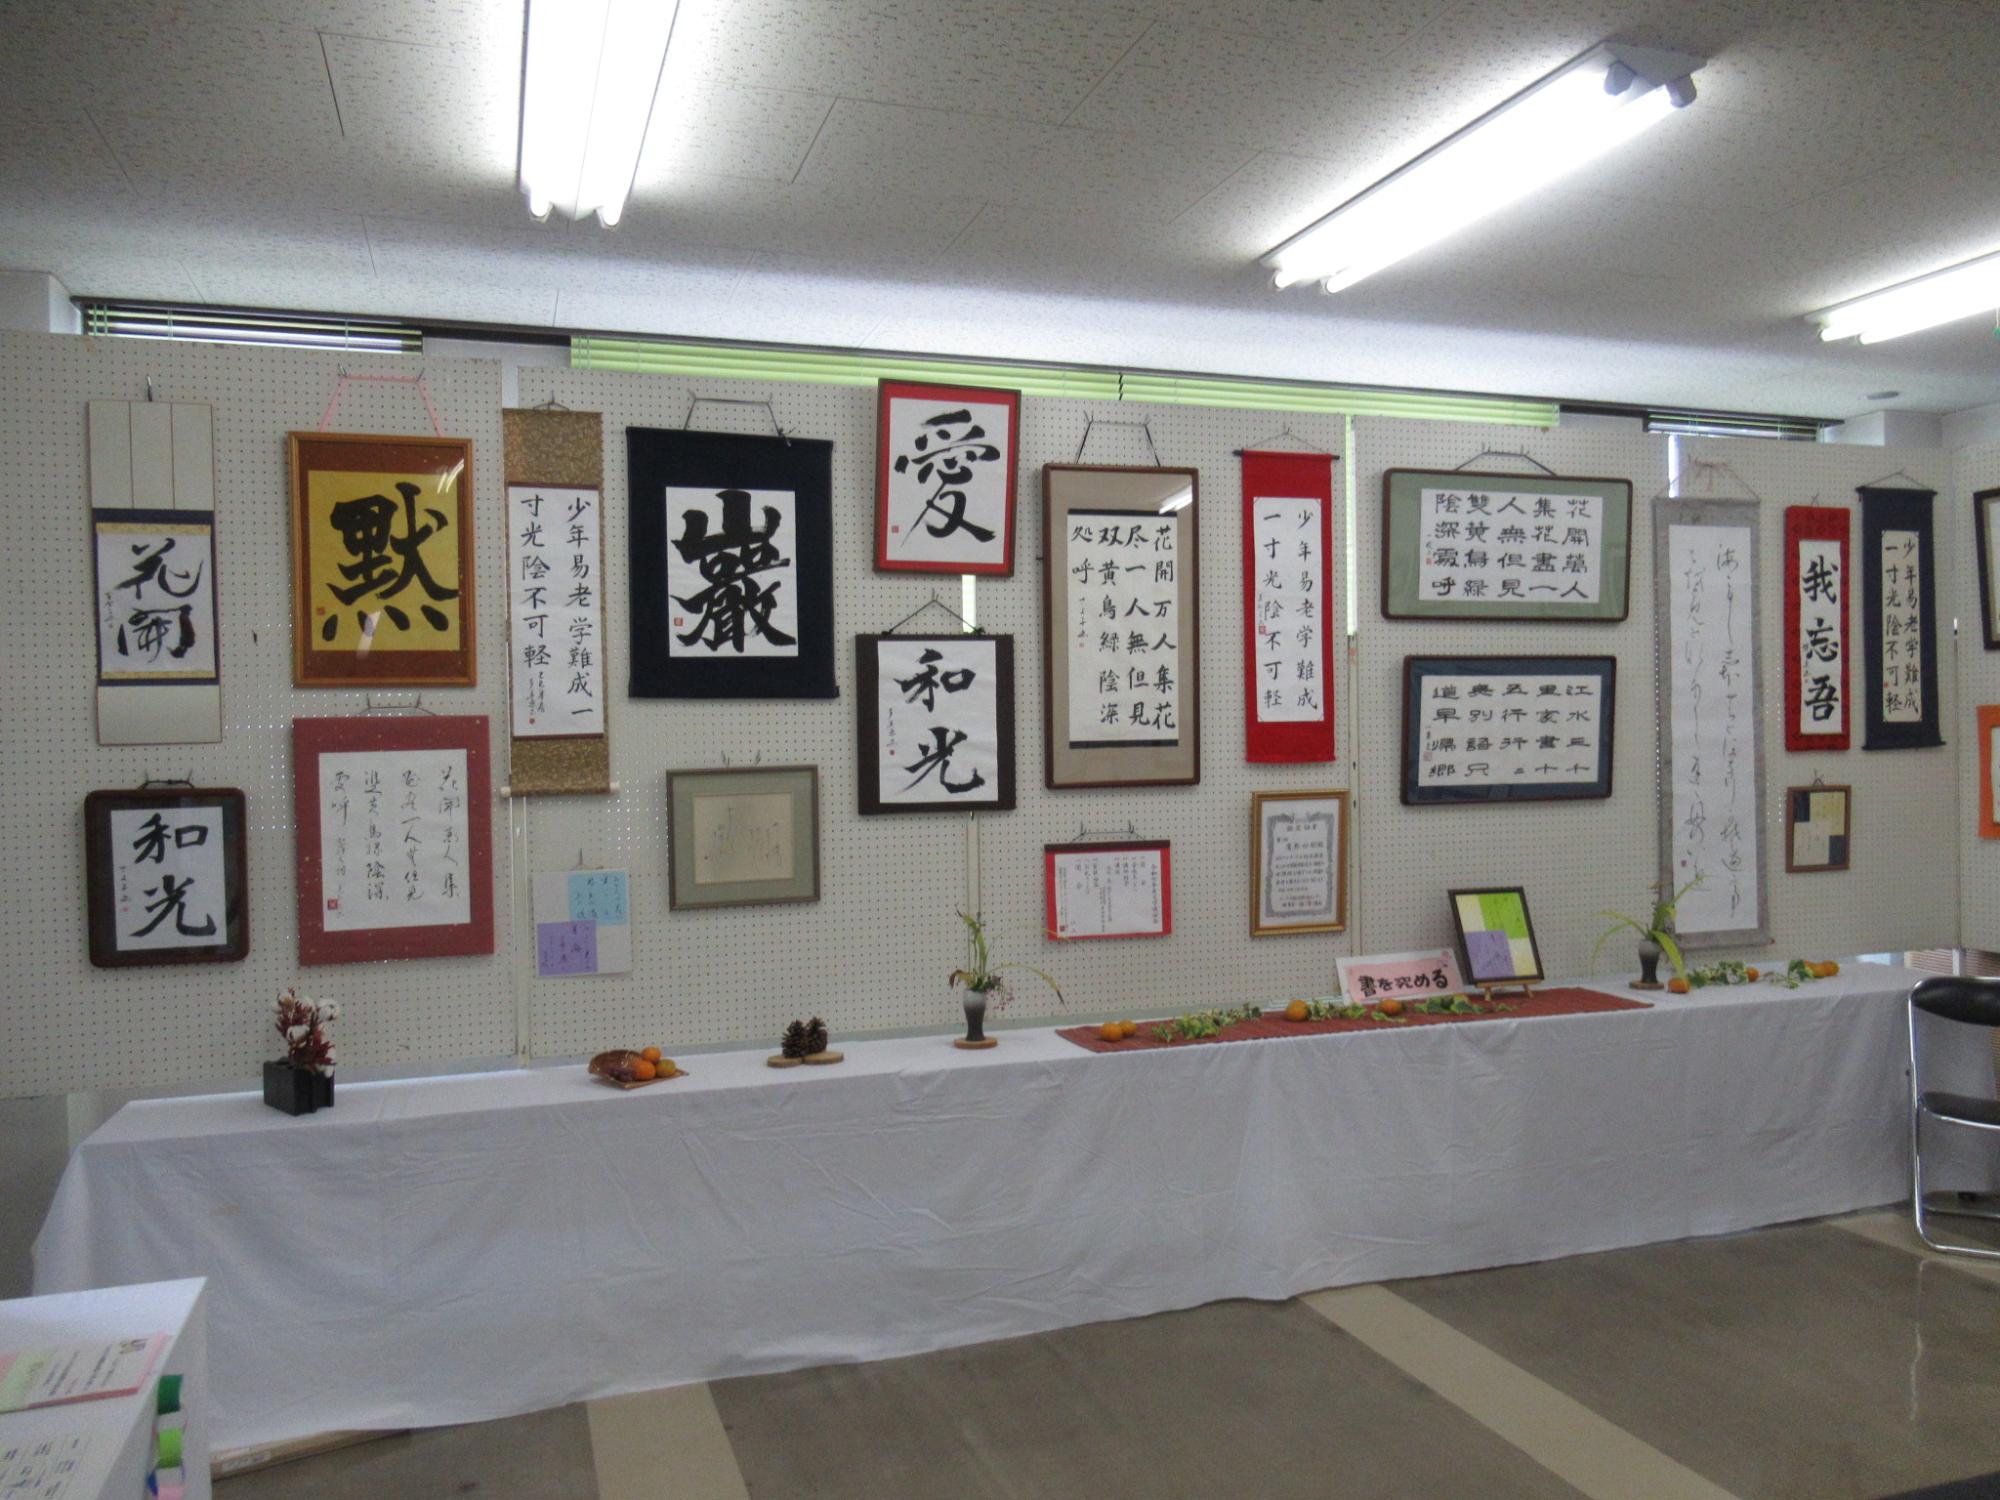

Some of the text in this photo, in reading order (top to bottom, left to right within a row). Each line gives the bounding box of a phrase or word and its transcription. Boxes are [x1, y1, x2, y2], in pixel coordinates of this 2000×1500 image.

[894, 409, 1000, 547] 愛
[1071, 525, 1094, 584] 処呼
[520, 494, 551, 668] 寸光陰不可軽
[566, 497, 594, 716] 少年易老学難成一
[1124, 524, 1150, 726] 尽一人無但見
[1151, 524, 1177, 730] 花開万人集花
[1262, 513, 1284, 708] 一寸光陰不可軽
[1296, 509, 1318, 709] 少年易老学難成
[1802, 555, 1839, 721] 我忘吾
[893, 648, 985, 794] 和光
[129, 813, 217, 937] 和光
[1358, 968, 1449, 997] 書を究める
